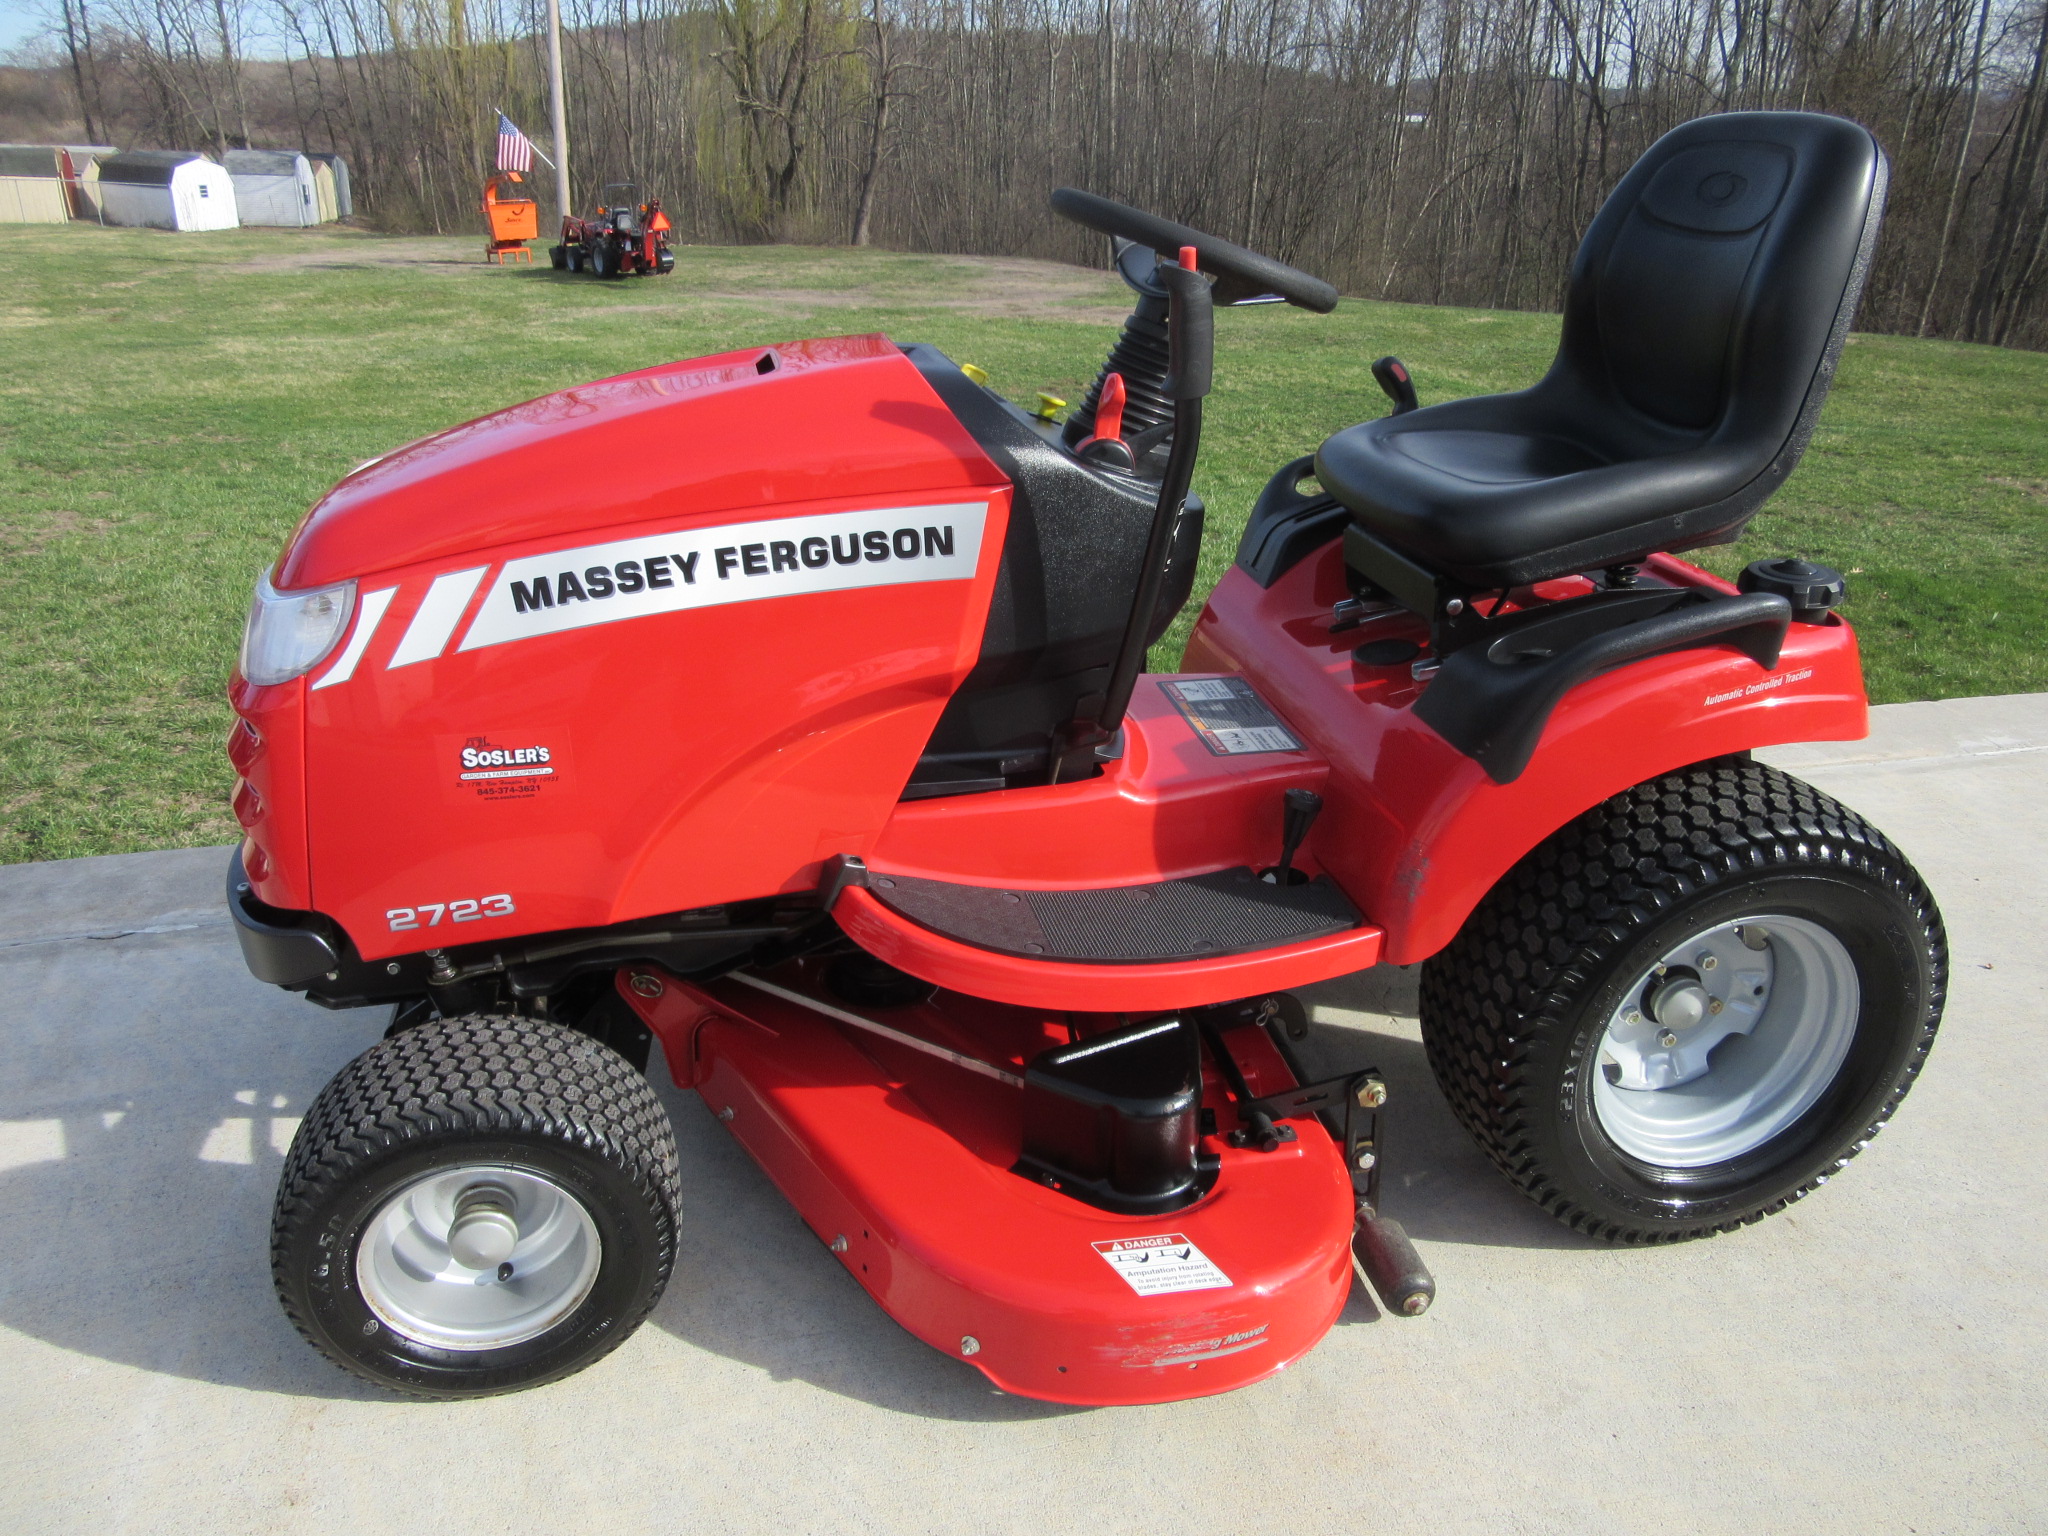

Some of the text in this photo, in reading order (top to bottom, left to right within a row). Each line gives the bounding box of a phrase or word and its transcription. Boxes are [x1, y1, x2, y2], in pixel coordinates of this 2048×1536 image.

[511, 525, 956, 614] MASSEY FERGUSON
[1703, 669, 1813, 706] Automatic Controlled Traction
[461, 745, 551, 769] SOSLER'S
[477, 785, 541, 796] 845-374-3621
[386, 893, 516, 932] 2723
[1124, 1237, 1173, 1250] DANGER
[1127, 1262, 1208, 1278] Amputation Hazard
[1225, 1324, 1270, 1344] Mower
